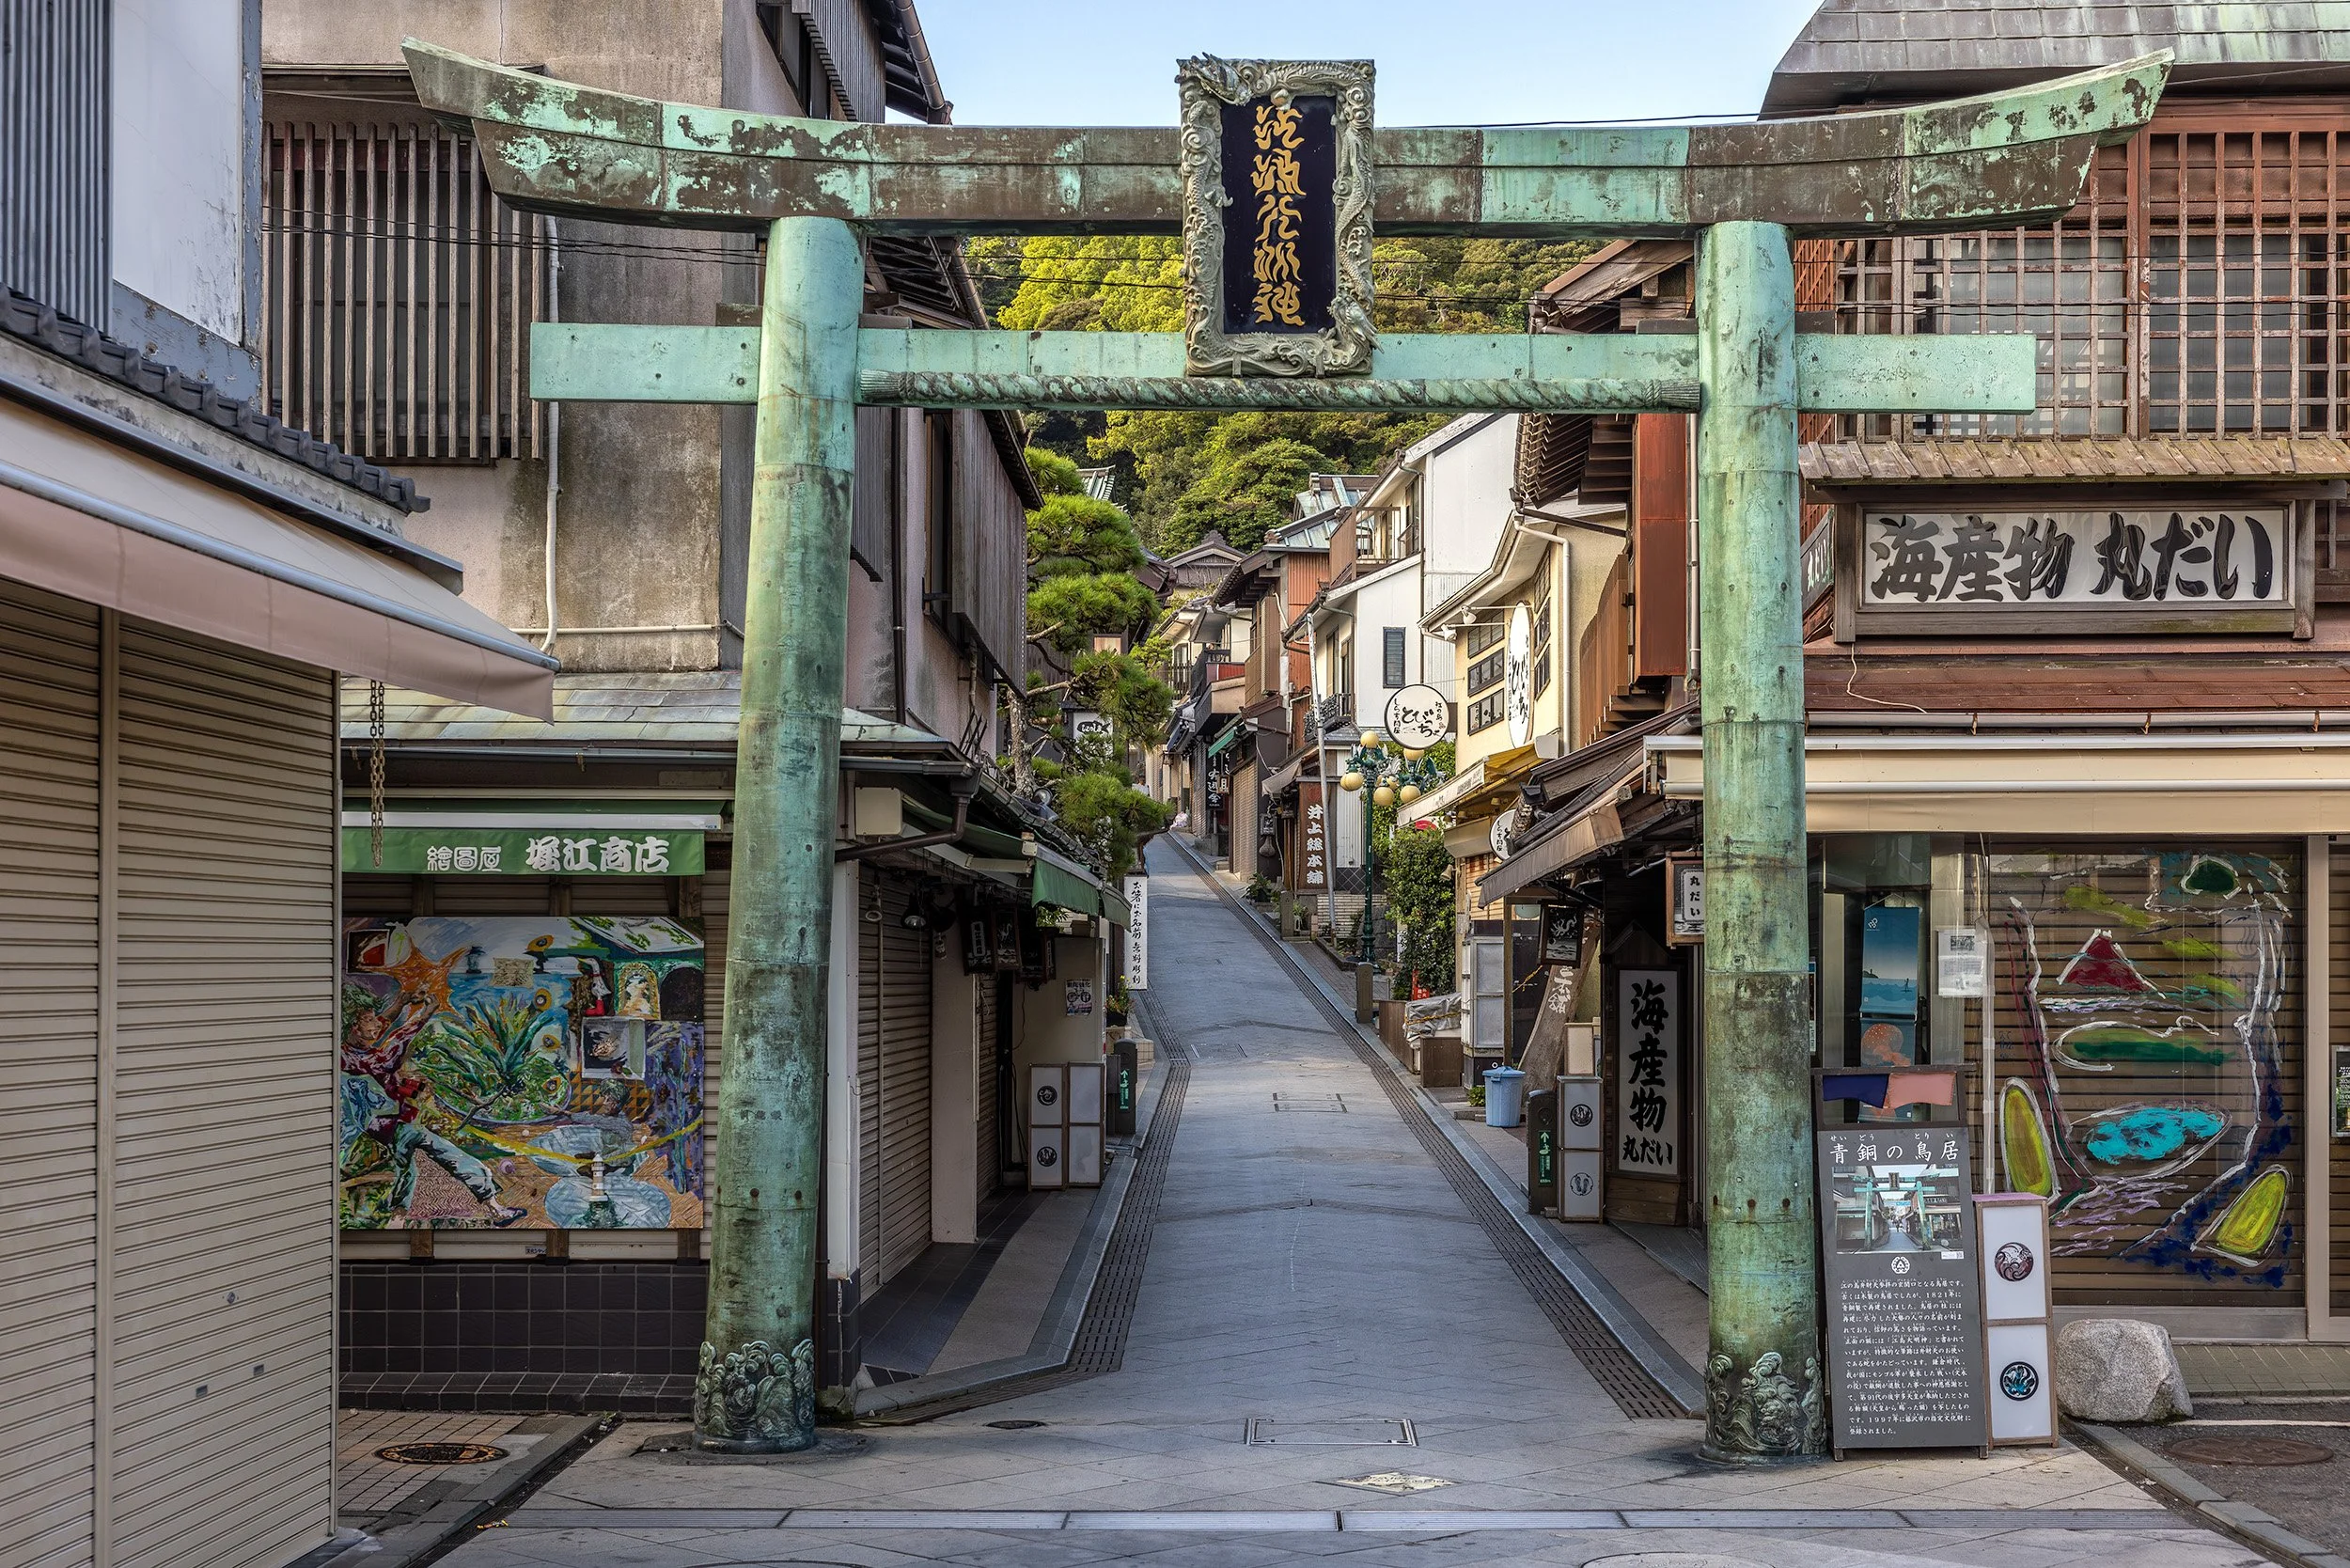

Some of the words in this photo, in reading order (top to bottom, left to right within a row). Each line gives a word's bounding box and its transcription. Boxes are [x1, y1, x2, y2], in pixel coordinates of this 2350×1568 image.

[1869, 512, 2076, 603] 海産物
[2089, 511, 2274, 602] 丸だい
[1402, 706, 1441, 738] とびっちょ
[525, 835, 670, 873] 堀江商店
[1131, 881, 1142, 940] お箸にお名前
[1689, 875, 1701, 917] 丸だい
[1132, 941, 1141, 984] 無料彫刻
[1628, 979, 1669, 1134] 海産物
[1622, 1135, 1672, 1167] 丸だい
[1829, 1140, 1959, 1165] 青銅の鳥居
[1914, 1132, 1930, 1140] とり
